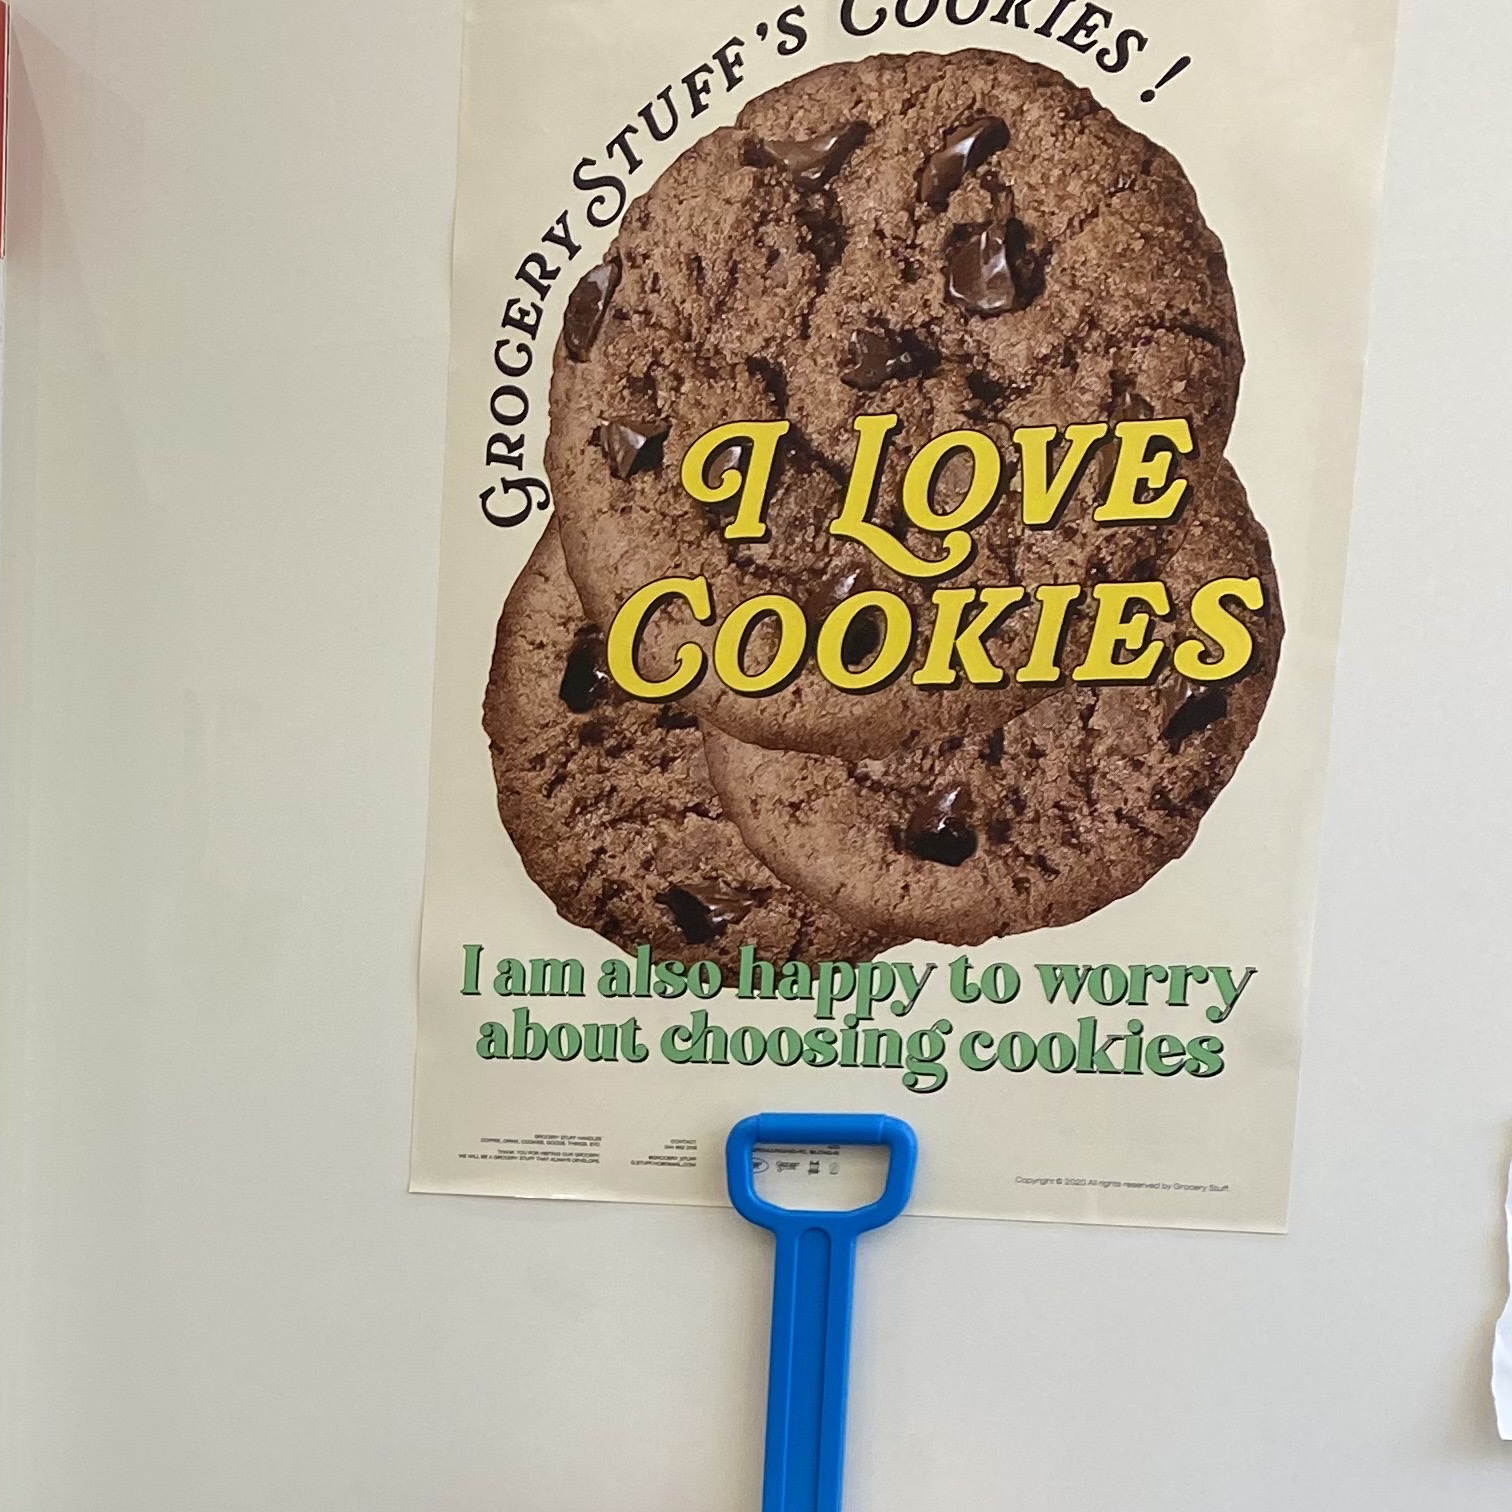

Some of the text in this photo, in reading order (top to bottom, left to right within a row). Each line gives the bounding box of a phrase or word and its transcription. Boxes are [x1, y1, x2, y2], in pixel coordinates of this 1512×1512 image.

[479, 216, 582, 528] GROCERY
[839, 0, 1149, 74] COOKIES
[681, 413, 1196, 579] I LOVE
[607, 575, 1265, 700] COOKIES
[461, 944, 1258, 1024] I am also happy to worry
[476, 1007, 1226, 1095] about choosing cookies
[1015, 1176, 1054, 1186] Copyright
[1099, 1180, 1121, 1189] rights
[1123, 1181, 1160, 1189] reserved
[1162, 1182, 1171, 1191] by
[1173, 1182, 1207, 1192] Grocery
